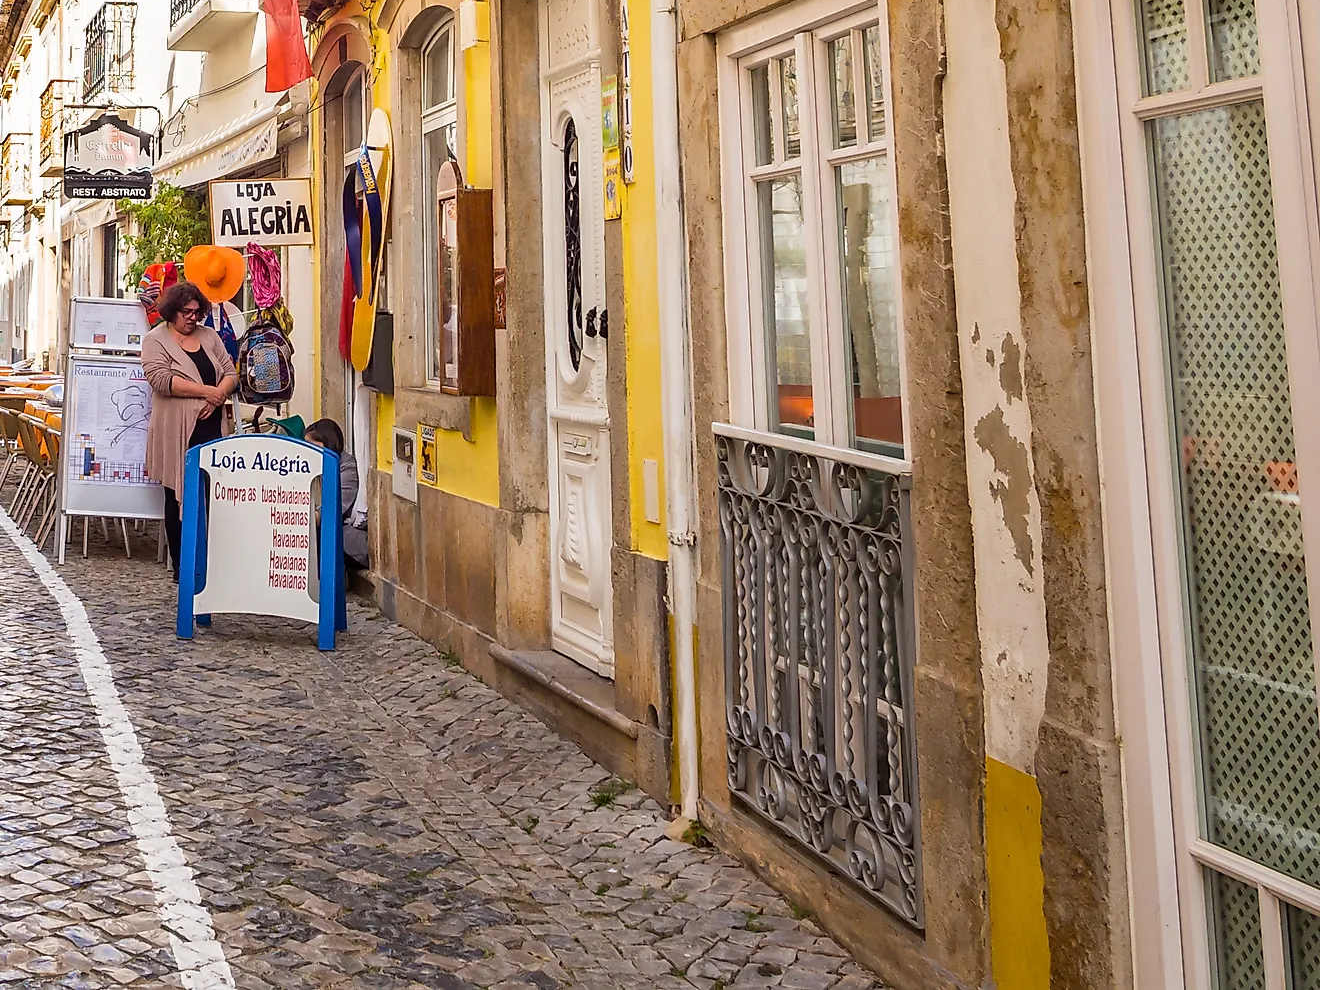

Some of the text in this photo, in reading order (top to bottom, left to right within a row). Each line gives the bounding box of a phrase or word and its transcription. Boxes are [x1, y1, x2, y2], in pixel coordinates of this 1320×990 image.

[73, 188, 146, 197] REST. ABSTRATO
[236, 182, 276, 201] LOJA
[220, 201, 311, 237] ALEGRIA
[74, 367, 127, 378] Restaurante
[211, 449, 246, 472] Loja
[215, 482, 310, 507] Compra as tuas Havaianas
[270, 506, 308, 526] Havaianas
[273, 529, 309, 549] Havaianas
[269, 551, 306, 572] Havaianas
[268, 570, 306, 591] Havaianas
